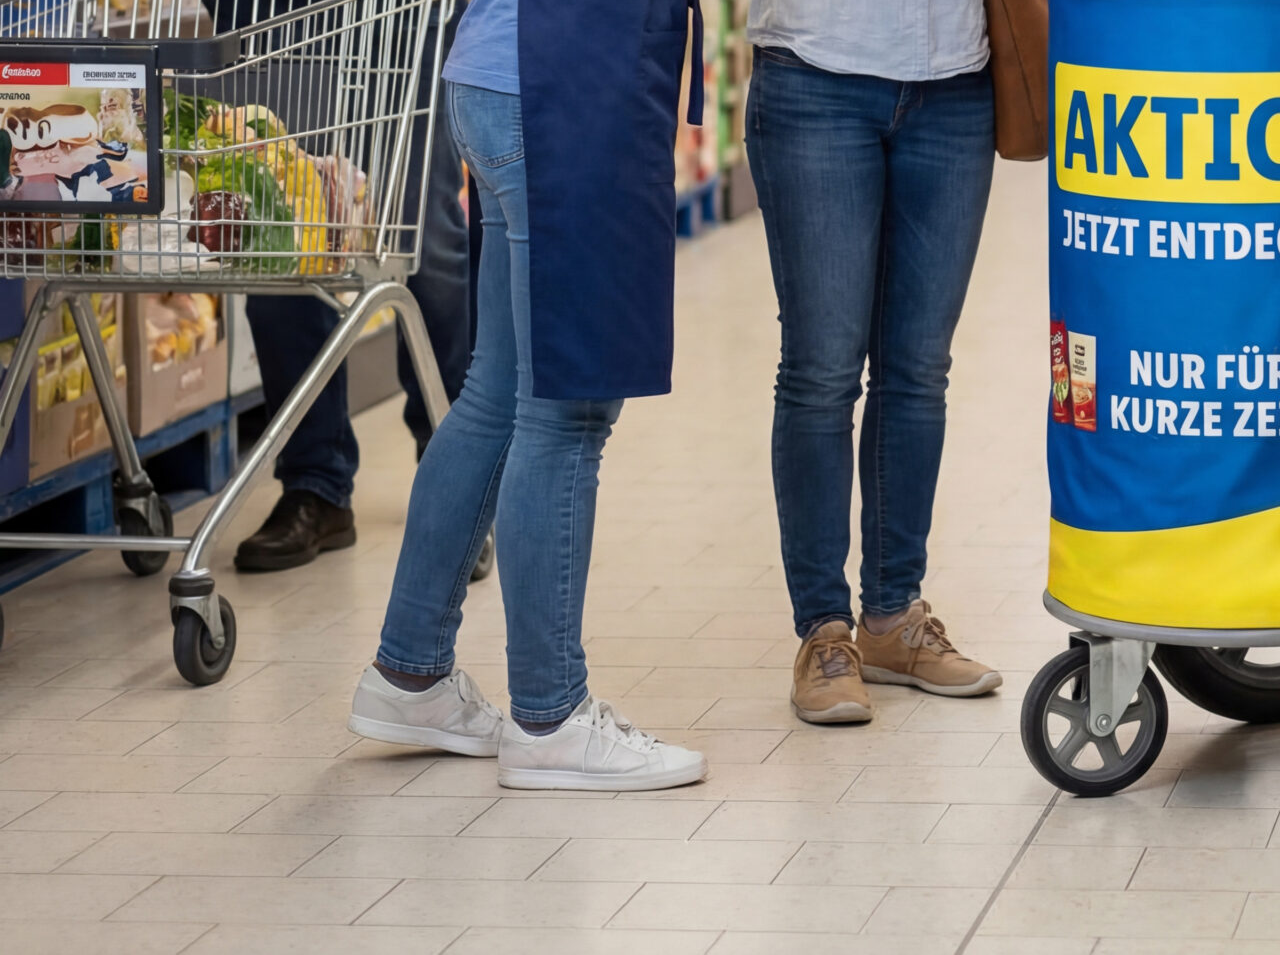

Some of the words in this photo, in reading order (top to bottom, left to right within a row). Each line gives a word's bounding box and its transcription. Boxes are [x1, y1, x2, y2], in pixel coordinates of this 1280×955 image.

[1063, 209, 1140, 257] JETZT
[1129, 350, 1205, 390] NUR
[1110, 395, 1223, 438] KURZE
